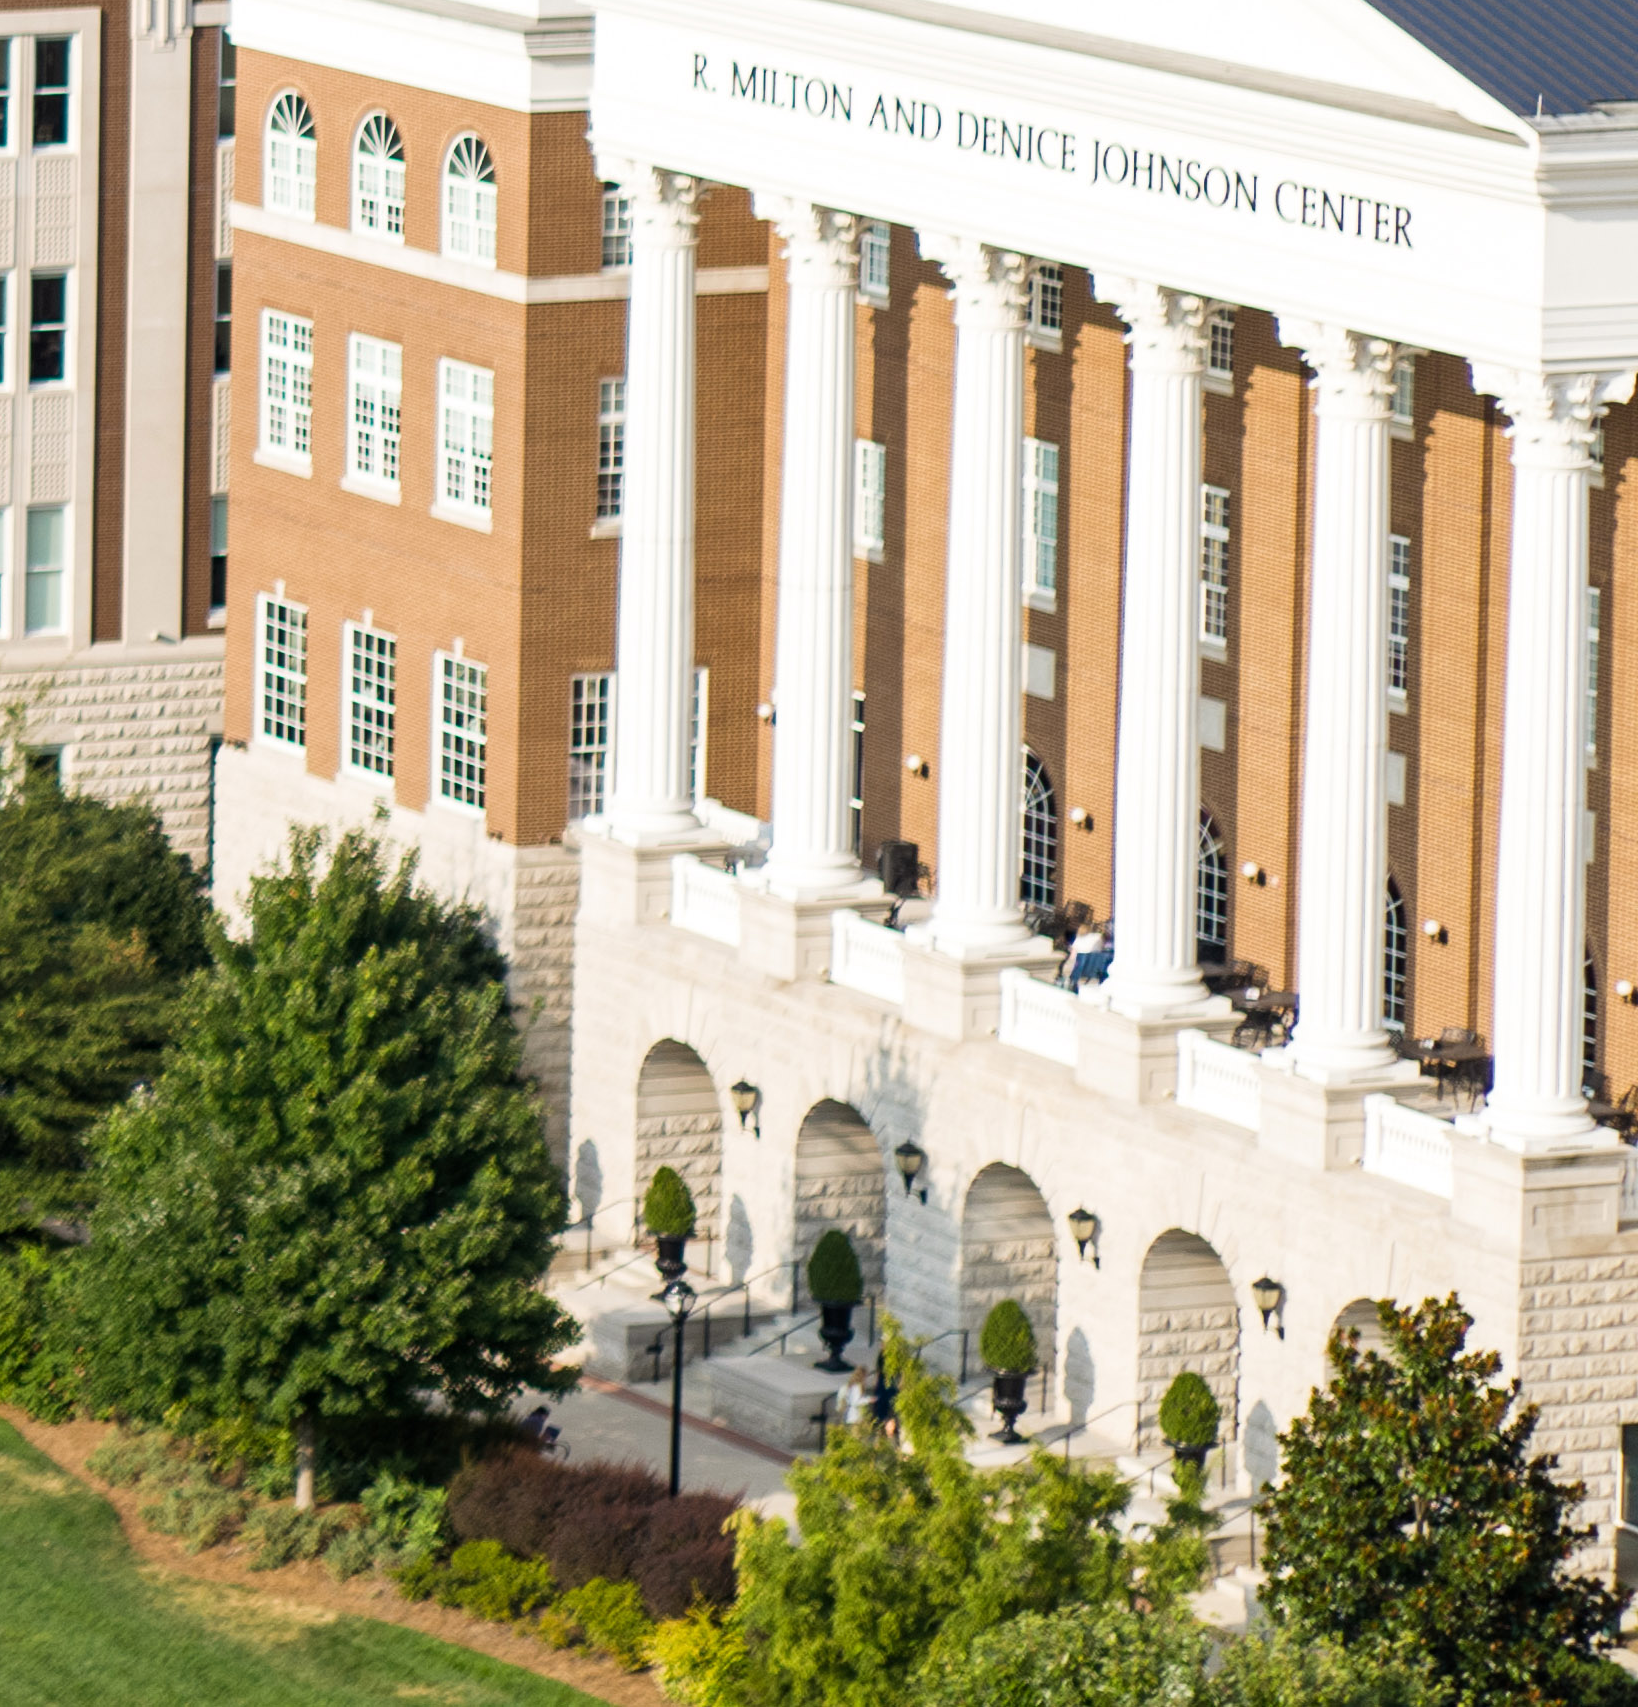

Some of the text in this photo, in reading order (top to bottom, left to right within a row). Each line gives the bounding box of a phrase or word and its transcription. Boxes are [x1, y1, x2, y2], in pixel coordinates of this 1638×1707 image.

[692, 52, 1415, 249] R. MILTON AND DENICE JOHNSON CENTER
